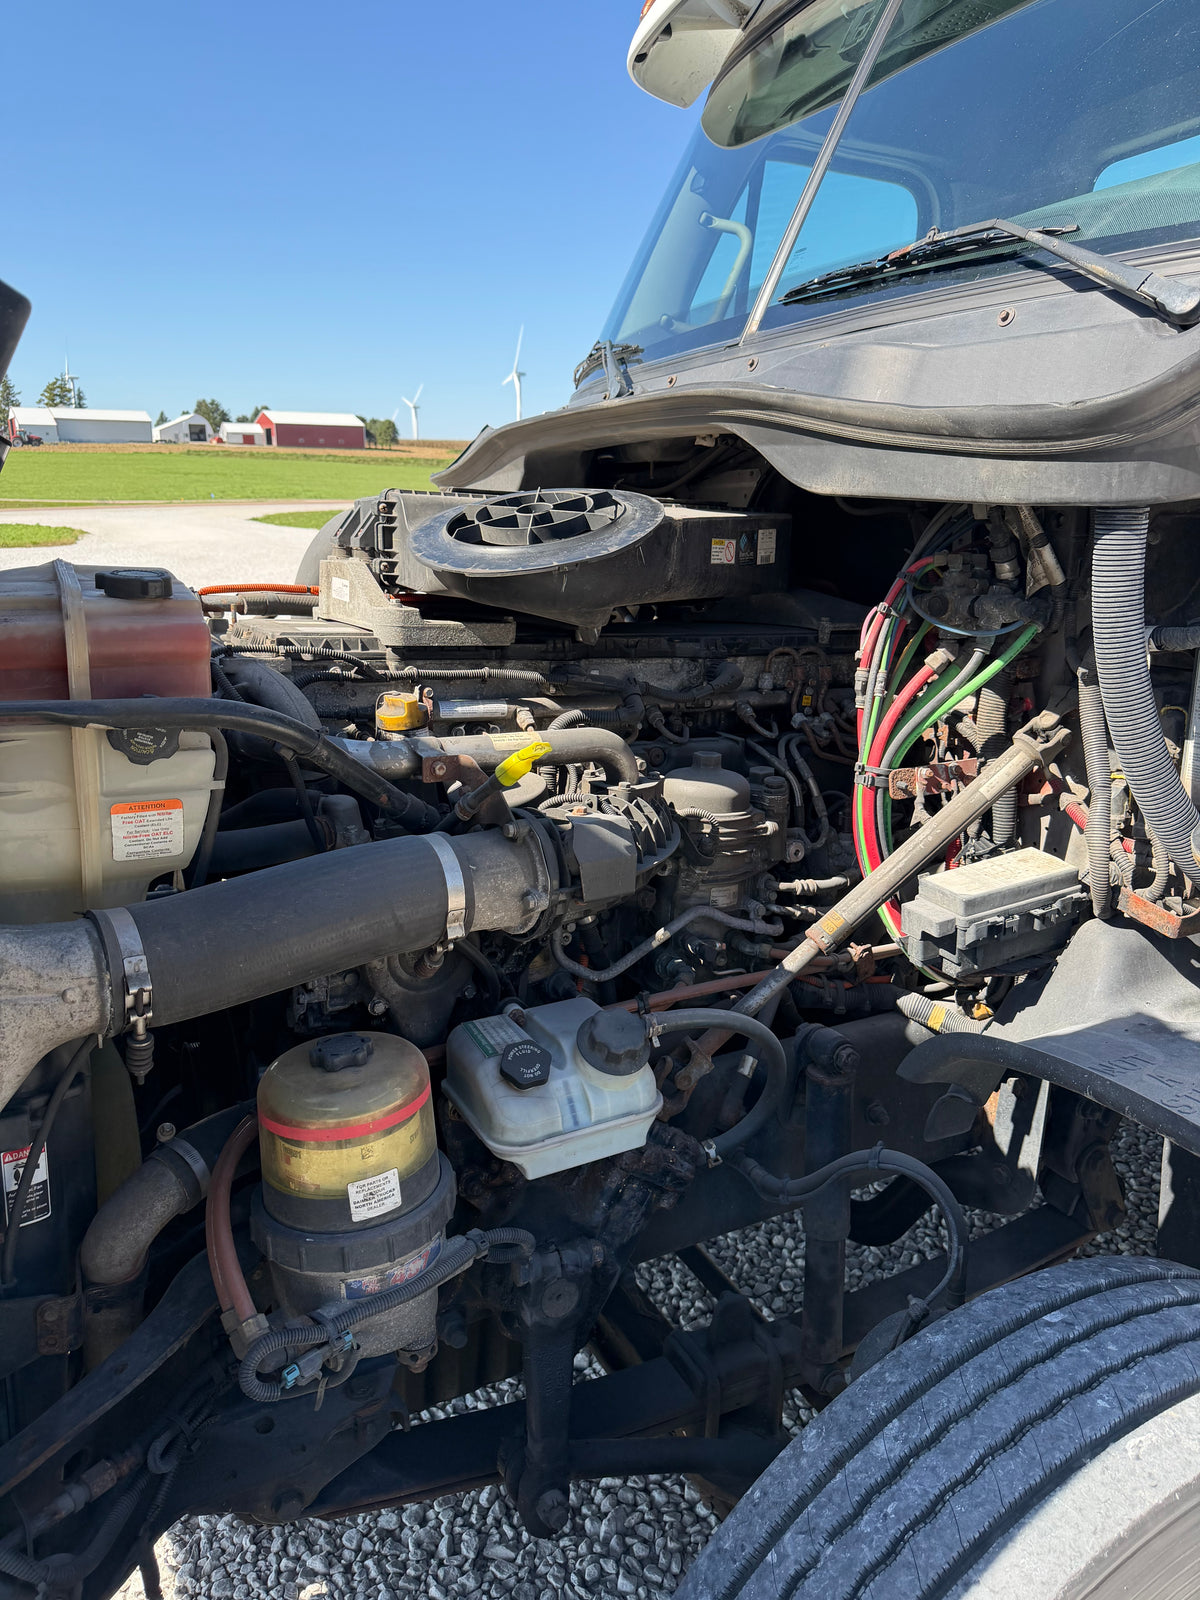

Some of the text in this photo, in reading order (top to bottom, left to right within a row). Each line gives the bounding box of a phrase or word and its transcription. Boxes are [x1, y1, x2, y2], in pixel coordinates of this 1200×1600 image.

[128, 803, 166, 811] ATTENTION
[507, 1044, 542, 1061] POWER STEERING
[515, 1049, 532, 1057] FLUID
[520, 1063, 541, 1074] OVERFILL
[1087, 1054, 1157, 1078] NOT
[366, 1178, 382, 1187] PARTS
[354, 1193, 395, 1210] NORTH AMERICA
